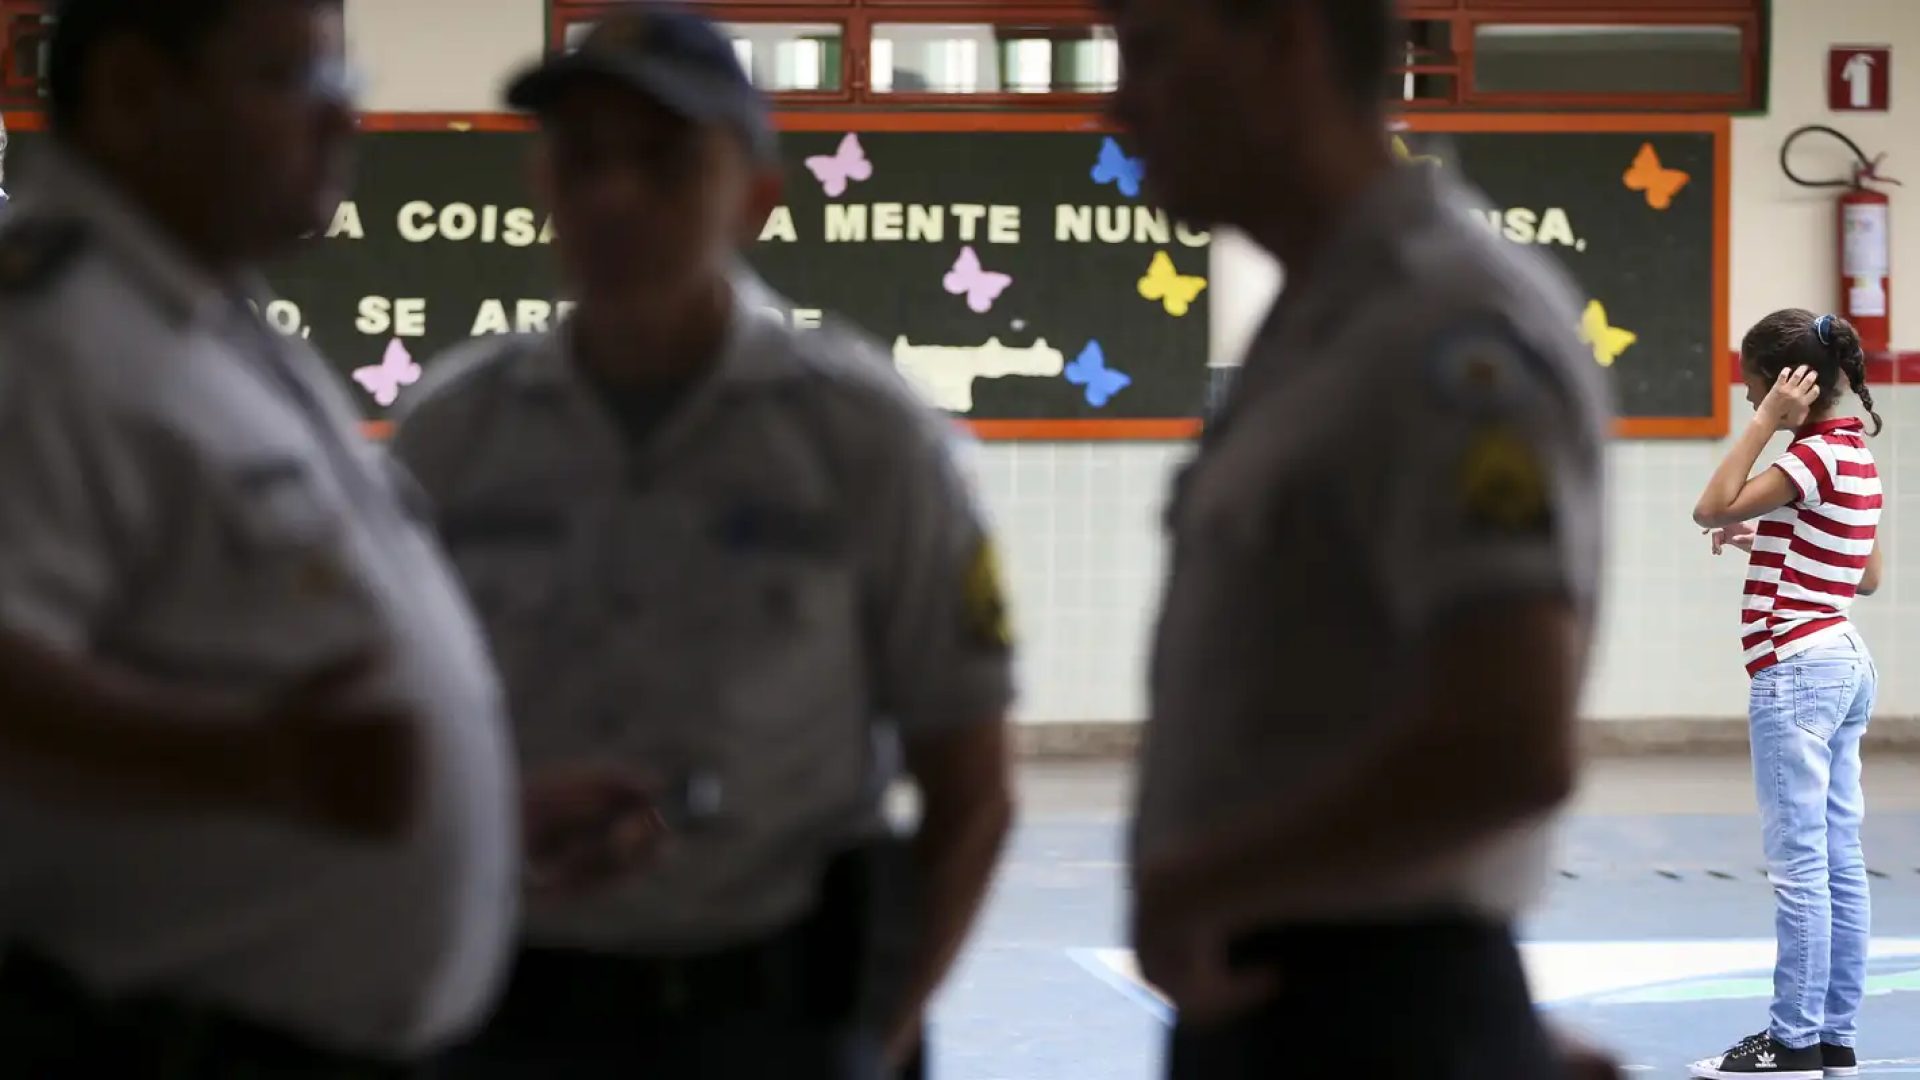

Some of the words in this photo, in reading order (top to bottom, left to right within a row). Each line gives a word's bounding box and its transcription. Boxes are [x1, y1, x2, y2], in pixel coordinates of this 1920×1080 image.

[302, 200, 365, 239] A
[756, 205, 798, 242] A
[824, 203, 1020, 244] MENTE
[1055, 204, 1211, 248] NUNC
[355, 295, 426, 337] SE
